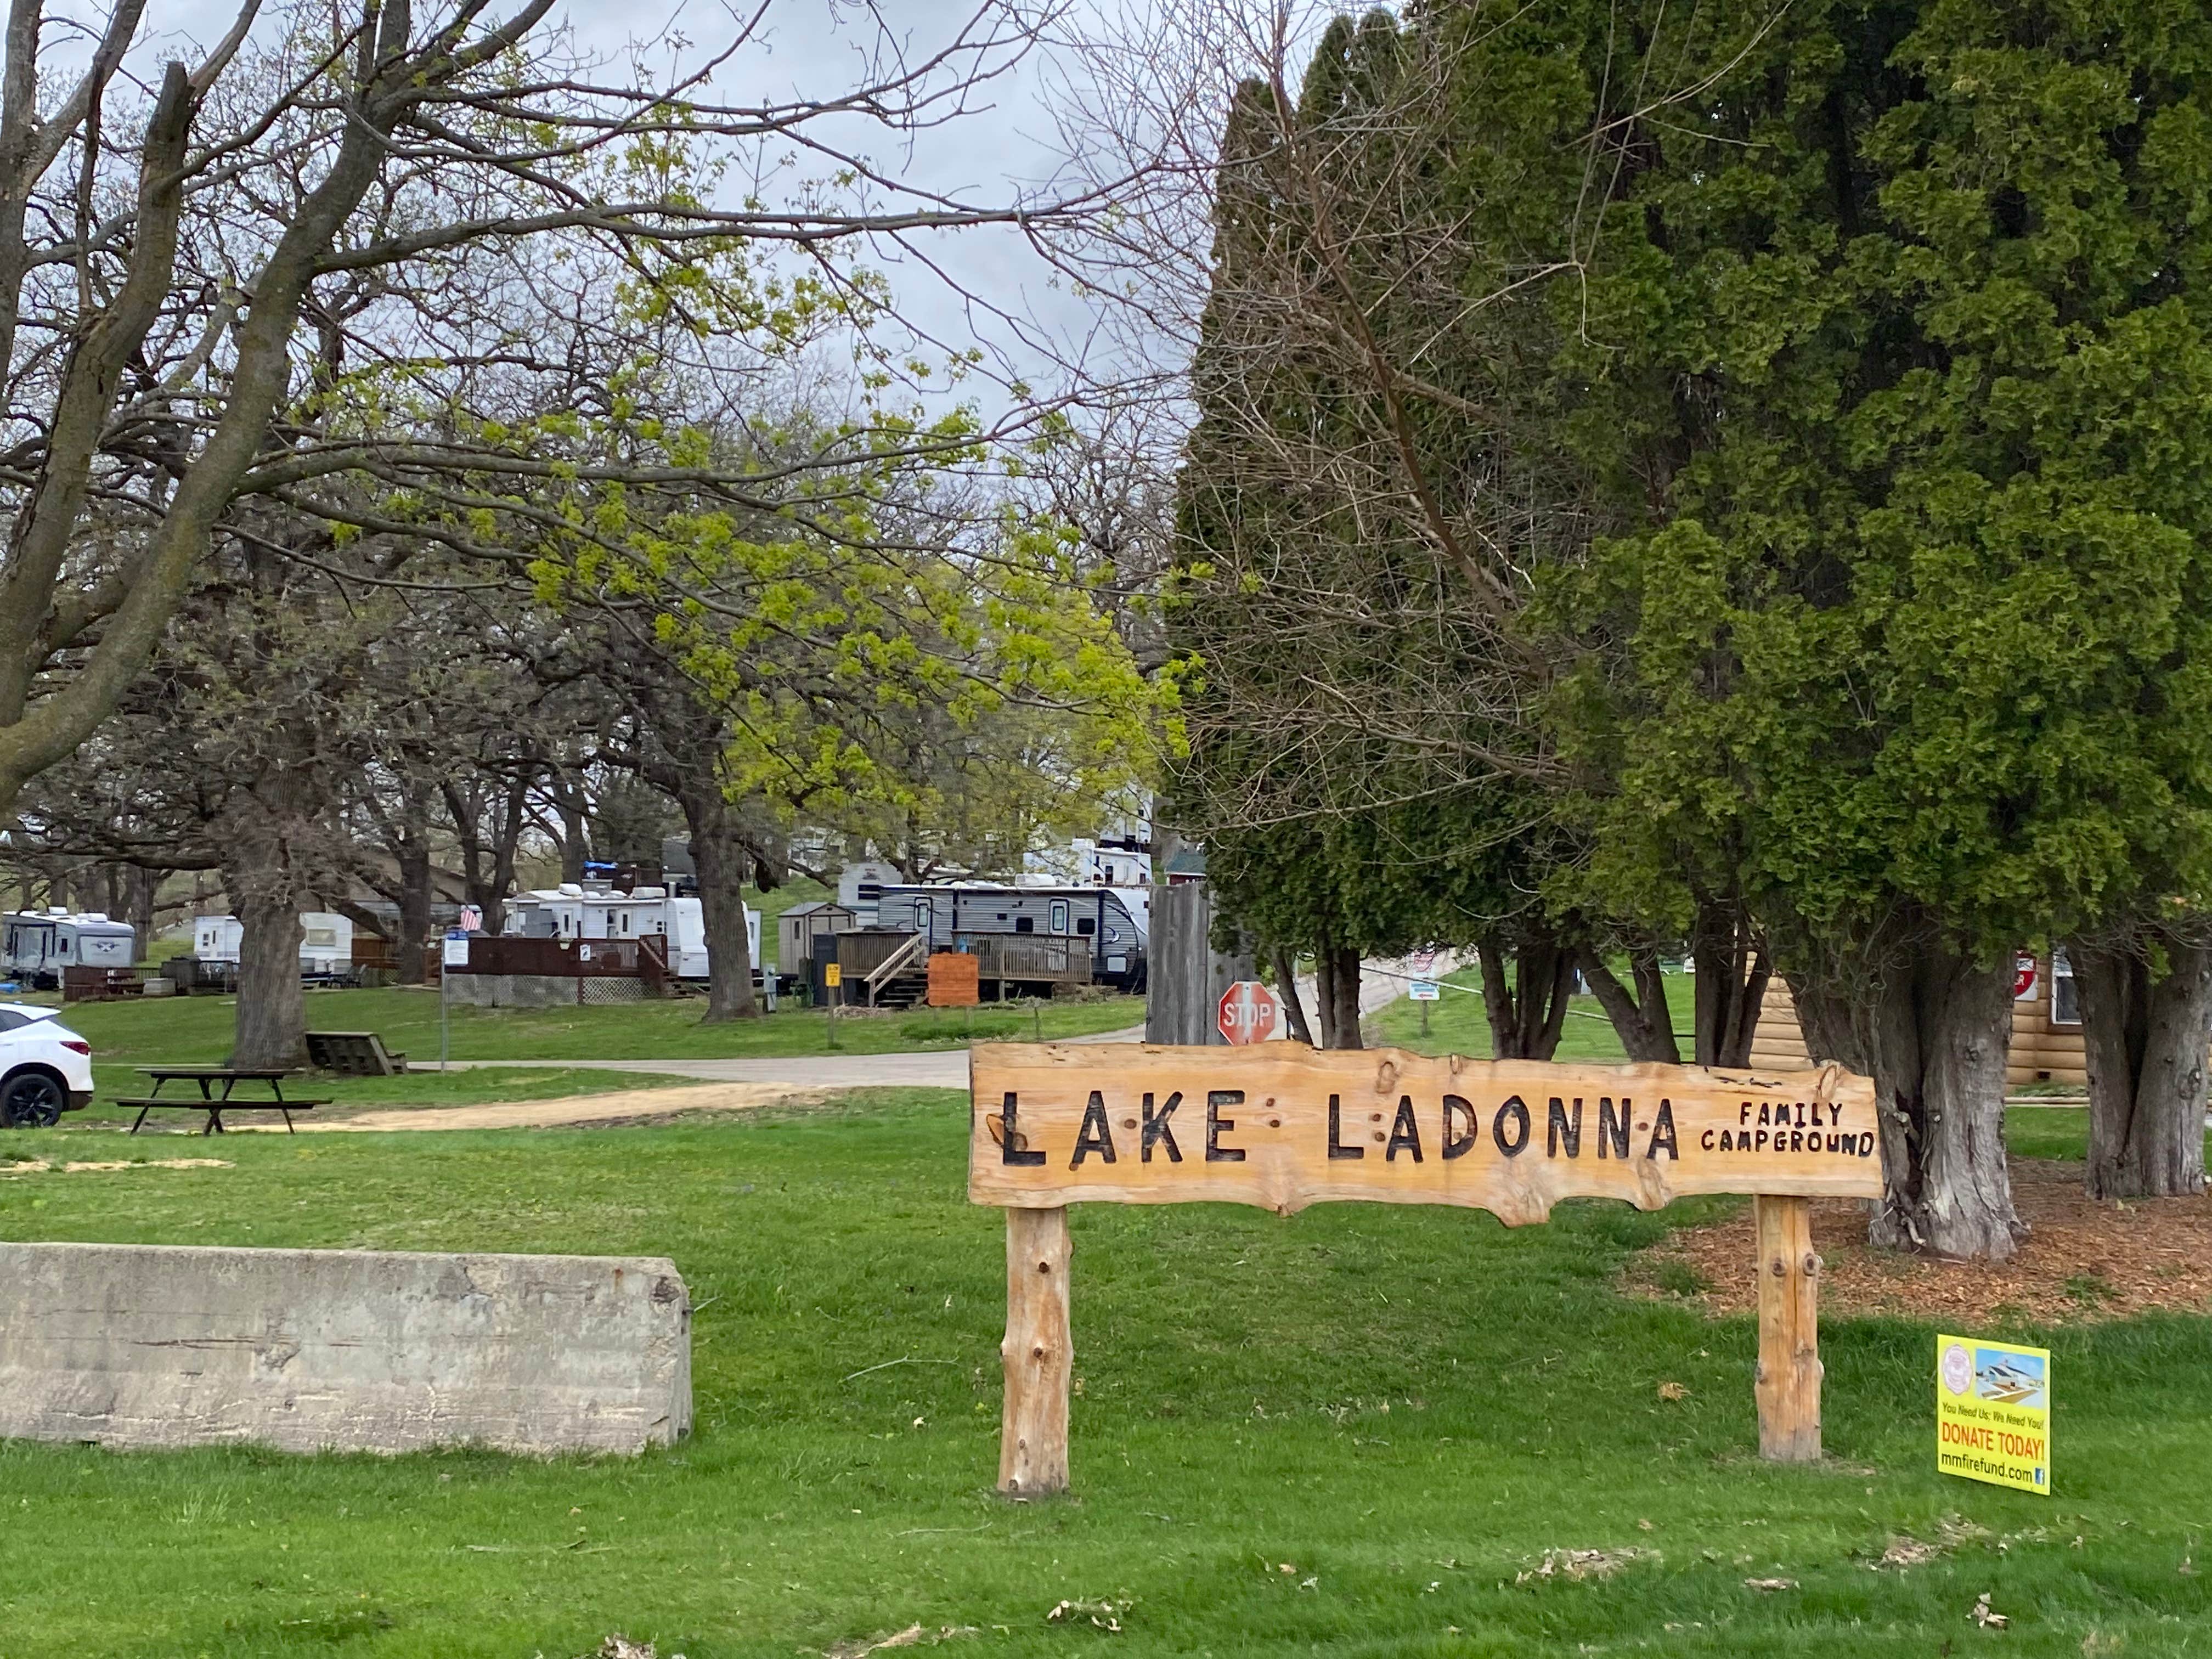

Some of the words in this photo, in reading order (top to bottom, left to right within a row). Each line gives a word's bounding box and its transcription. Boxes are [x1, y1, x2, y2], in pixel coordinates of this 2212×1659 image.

[1223, 1002, 1271, 1026] STOP
[1003, 1090, 1246, 1166] LAKE
[1328, 1094, 1679, 1163] LADONNA
[1740, 1102, 1842, 1128] FAMILY
[1701, 1129, 1874, 1156] CAMPGROUND
[1942, 1402, 1956, 1414] You
[1958, 1404, 1977, 1417] Need
[1993, 1410, 2005, 1423] We
[2006, 1413, 2025, 1426] Need
[1942, 1422, 1994, 1451] DONATE
[1997, 1432, 2044, 1461] TODAY!
[1942, 1453, 2032, 1483] mmfirefund.com
